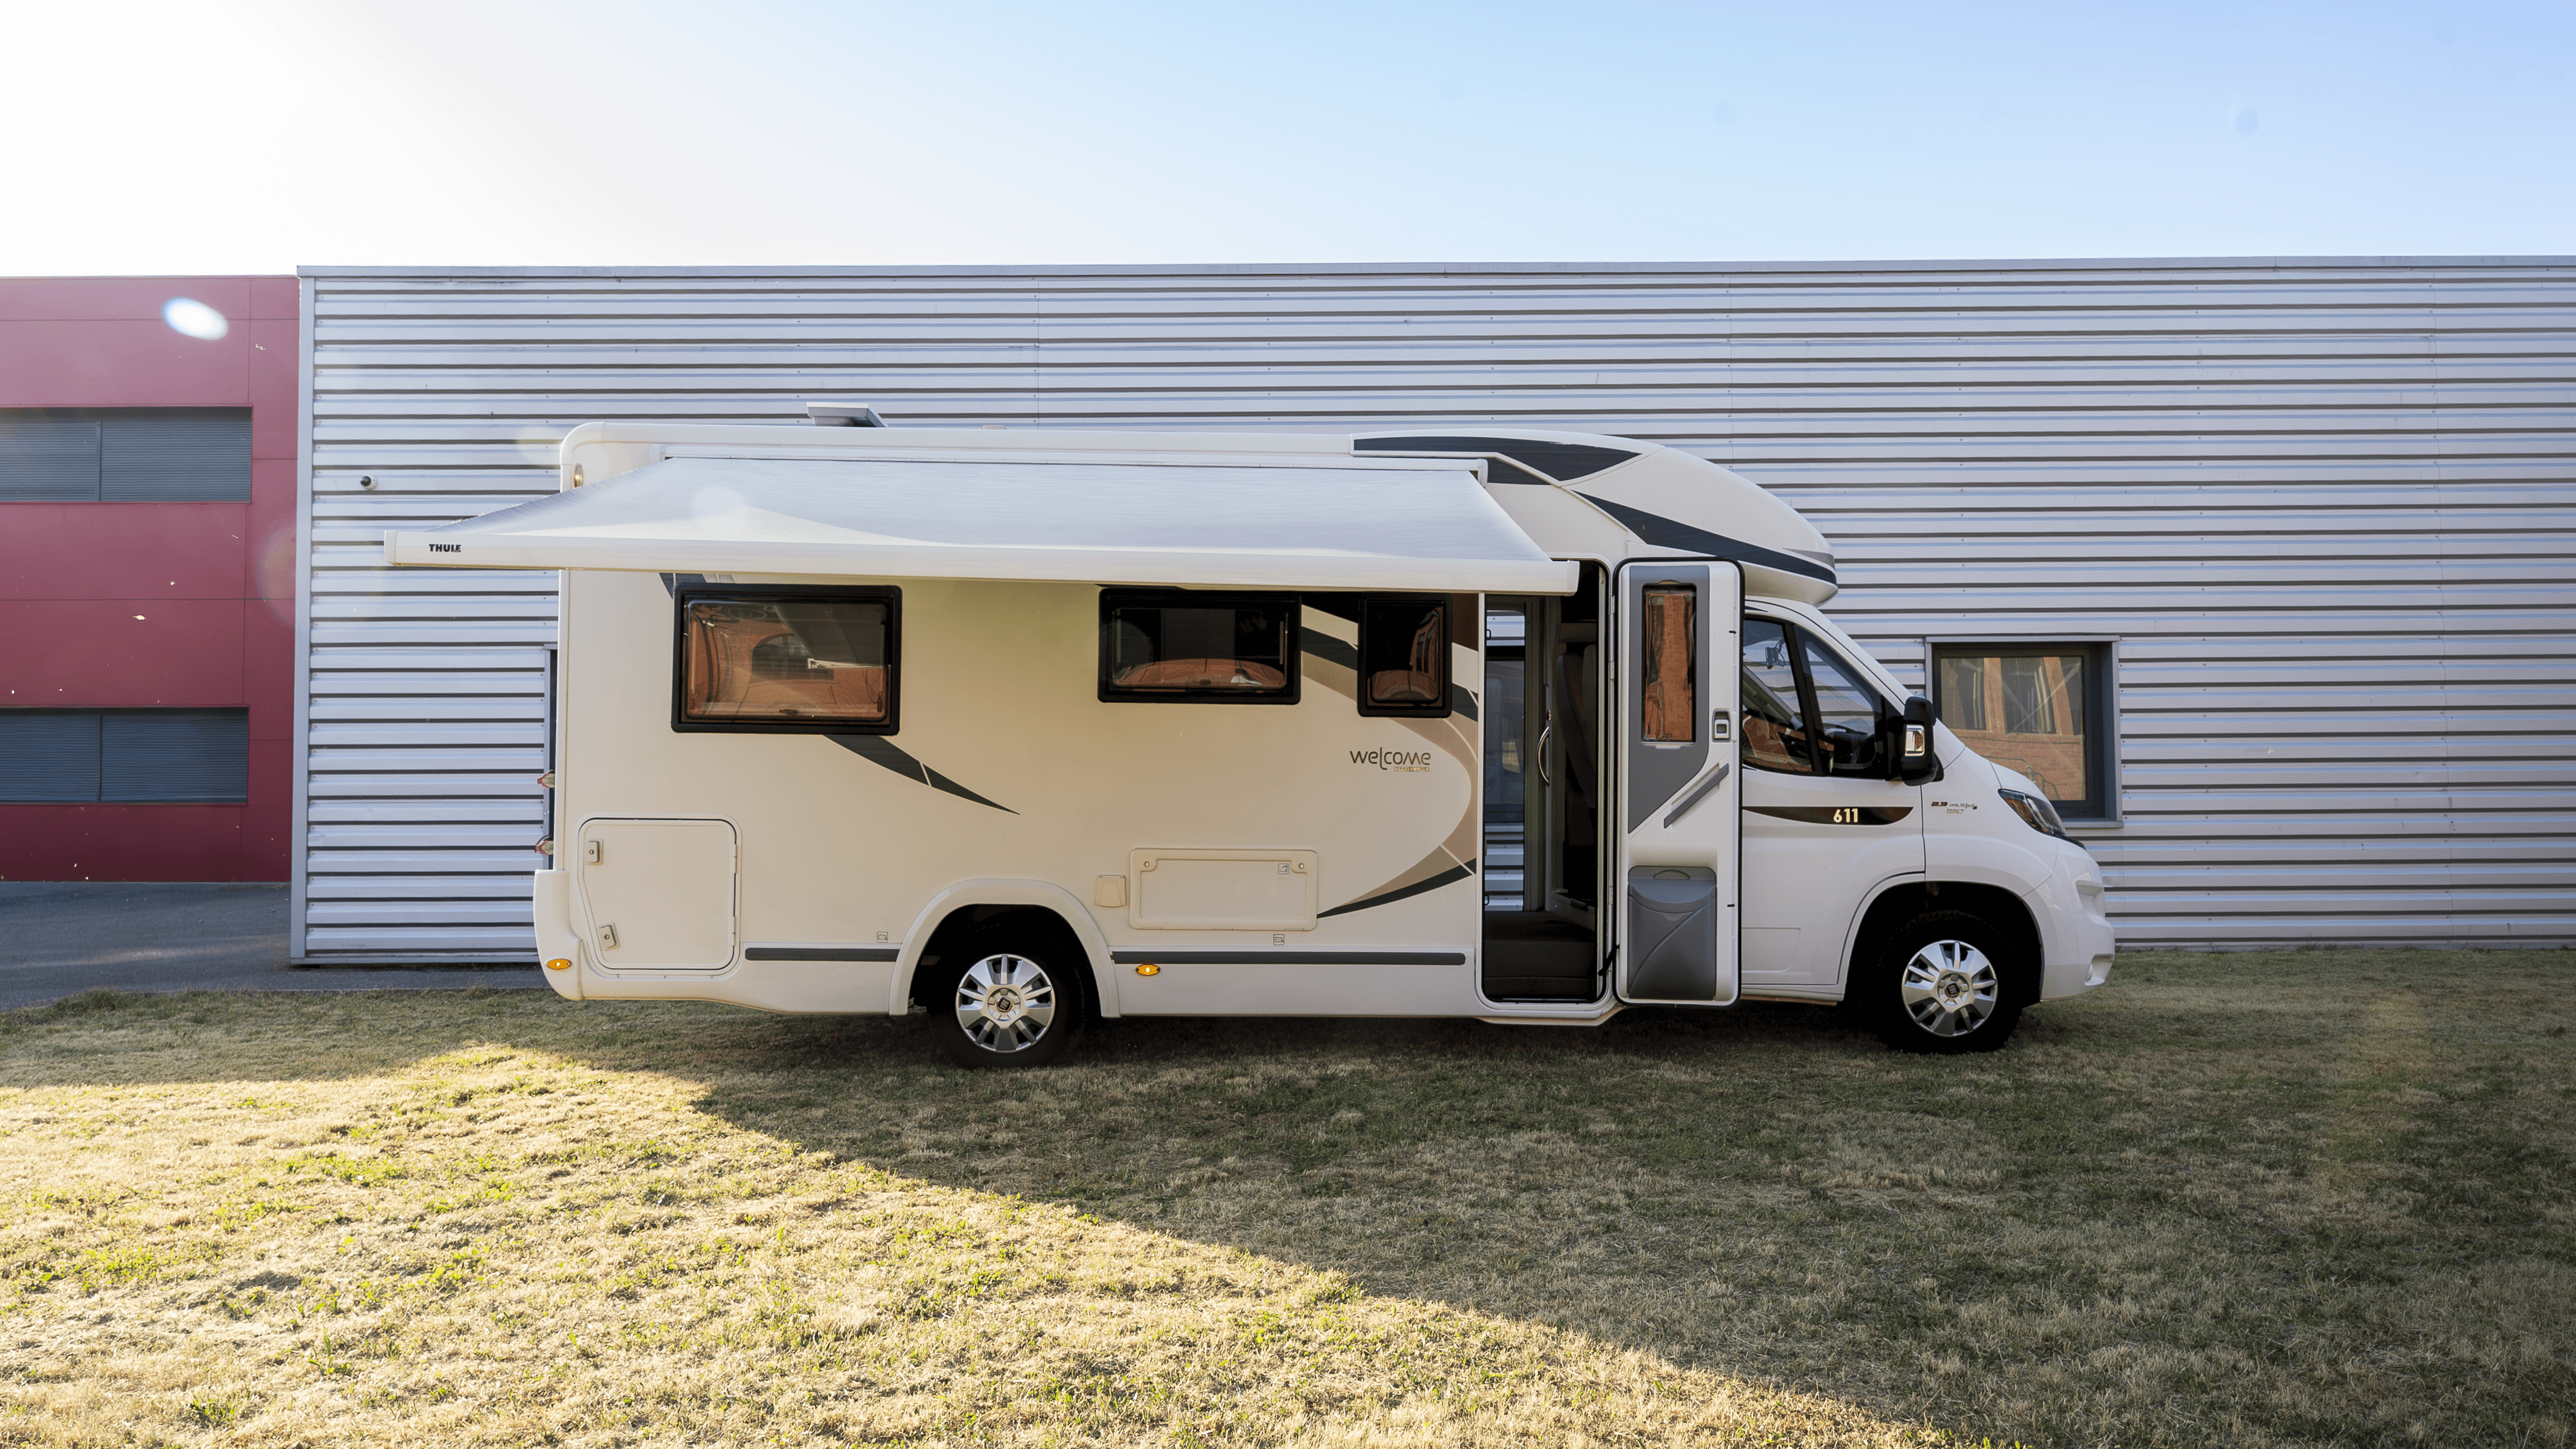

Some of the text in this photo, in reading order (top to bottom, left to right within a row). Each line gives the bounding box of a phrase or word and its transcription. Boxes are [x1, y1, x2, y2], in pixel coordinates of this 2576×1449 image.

[429, 544, 461, 553] THULE
[1350, 747, 1431, 770] welcome
[1833, 808, 1859, 823] 611
